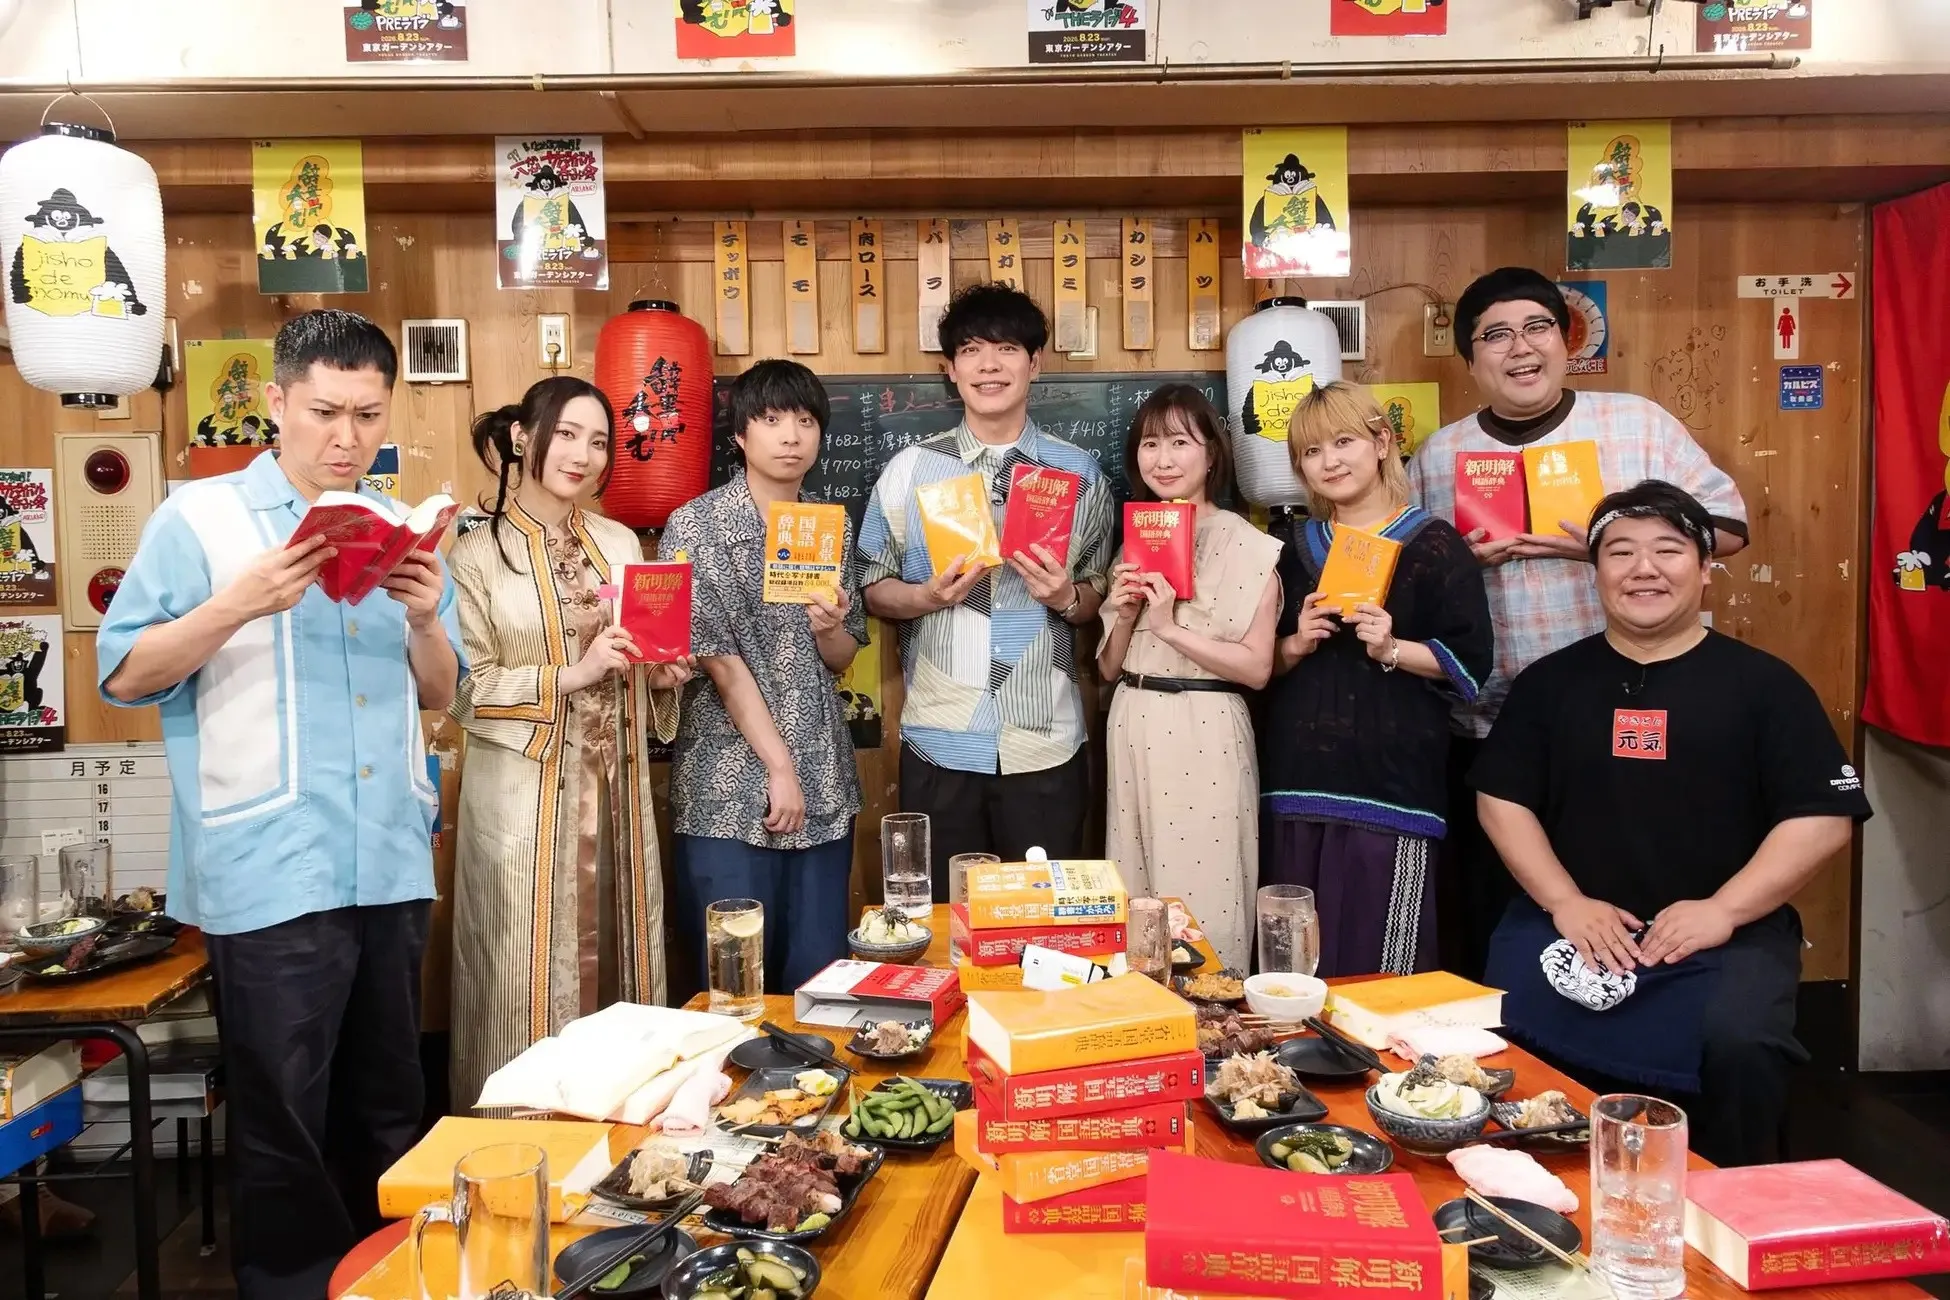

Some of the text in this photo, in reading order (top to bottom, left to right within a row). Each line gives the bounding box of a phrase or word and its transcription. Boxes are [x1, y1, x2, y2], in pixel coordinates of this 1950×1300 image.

[362, 42, 453, 52] 東京ガーデンシアター
[1045, 42, 1132, 53] 東京ガーデンシアター
[31, 251, 93, 271] jisho
[721, 233, 740, 300] テッポウ
[791, 233, 810, 293] モモ
[925, 231, 943, 290] バラ
[1061, 232, 1079, 291] ハラミ
[1130, 230, 1146, 290] カシラ
[1196, 230, 1213, 289] ハツ
[39, 270, 74, 285] de
[1755, 277, 1812, 287] お手洗
[33, 286, 91, 302] nomu
[1783, 380, 1818, 389] カルピス
[1069, 420, 1107, 440] ¥418
[825, 434, 862, 451] ¥682
[821, 458, 861, 475] ¥770
[1465, 459, 1515, 475] 新明解
[1020, 474, 1070, 496] 新明解
[1471, 476, 1505, 486] 国語辞典
[824, 484, 862, 499] ¥682
[1026, 494, 1057, 507] 国語辞典
[1132, 510, 1180, 528] 新明解
[777, 513, 794, 546] 辞典
[798, 516, 816, 547] 国語
[1140, 530, 1171, 539] 国語辞典
[633, 572, 683, 591] 新明解
[1617, 730, 1662, 751] 元気
[70, 760, 136, 777] 月予定
[97, 784, 108, 795] 16
[98, 802, 108, 813] 17
[98, 821, 109, 831] 18
[1013, 1071, 1166, 1111] 新明解国語辞典
[985, 1116, 1143, 1143] 新明解国語辞典
[1200, 1251, 1424, 1293] 新明解国語辞典
